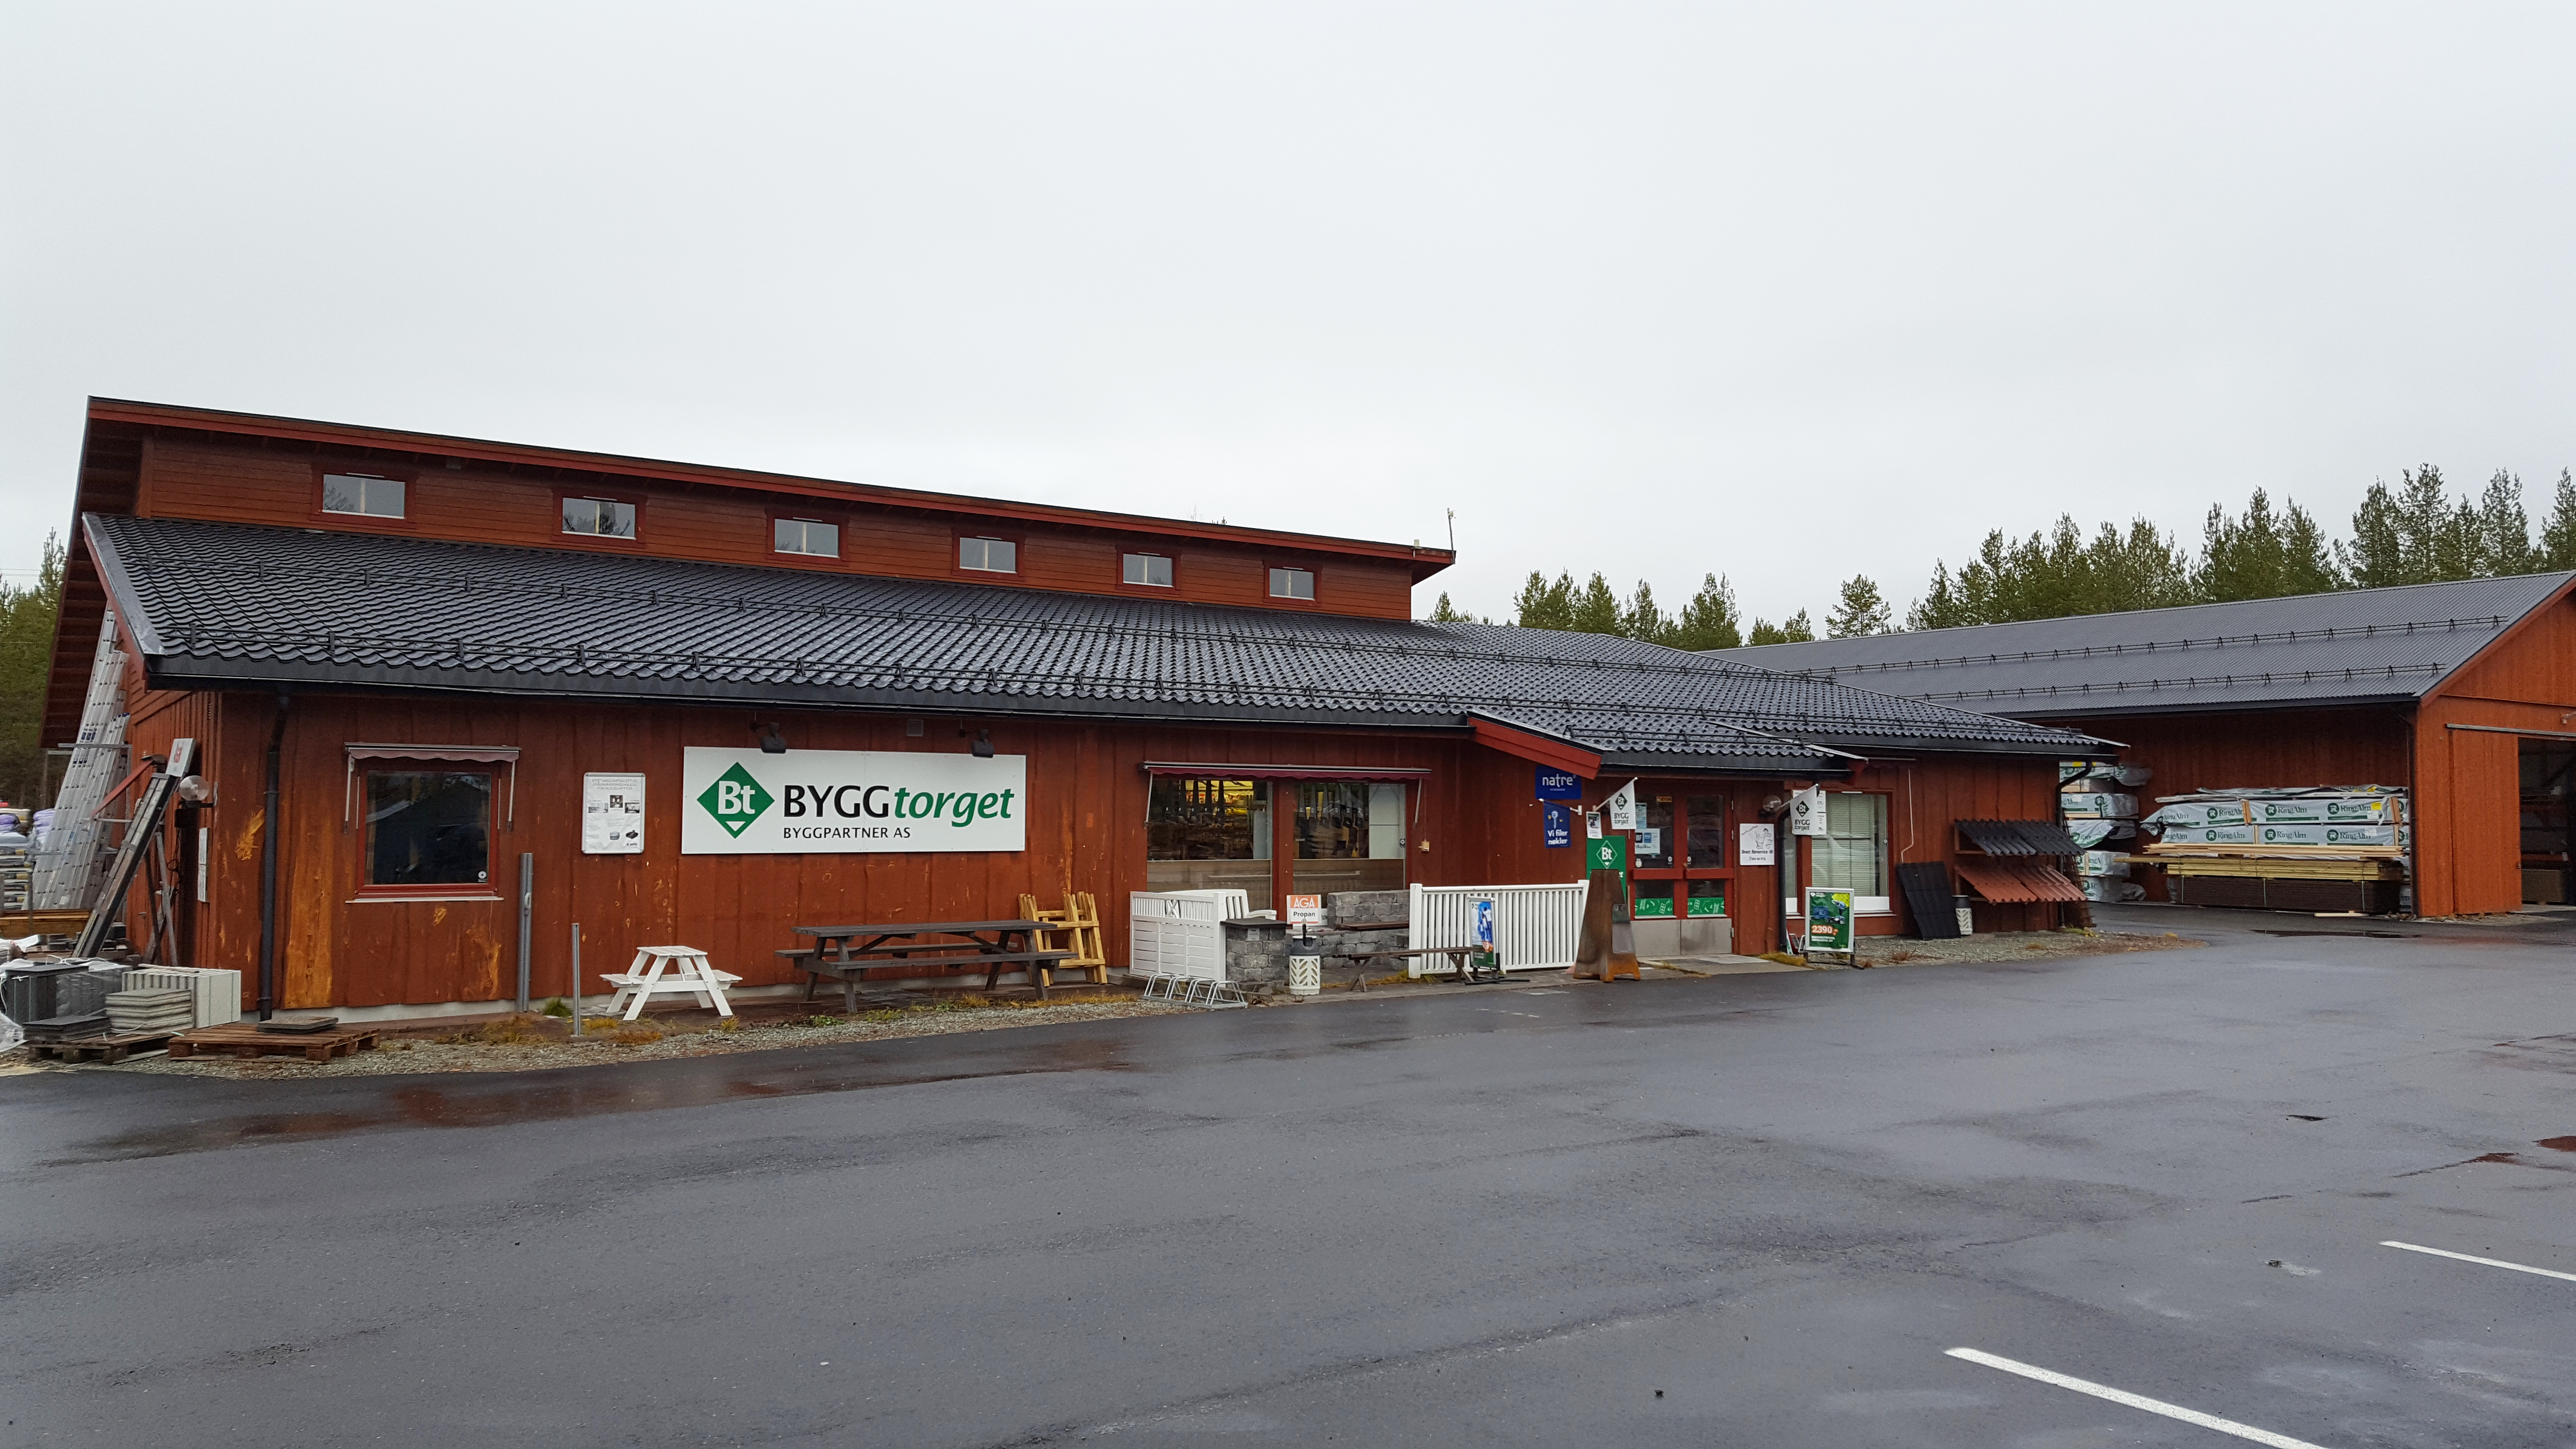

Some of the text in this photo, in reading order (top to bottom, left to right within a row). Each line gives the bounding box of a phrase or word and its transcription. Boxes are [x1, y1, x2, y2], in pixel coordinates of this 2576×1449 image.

[1543, 773, 1573, 788] natre
[718, 781, 755, 815] Bt
[784, 785, 1015, 827] BYGGtorget
[2341, 805, 2371, 813] RingAlm
[783, 827, 910, 838] BYGGPARTNER AS
[1602, 847, 1612, 860] Bt
[1293, 897, 1315, 908] AGA
